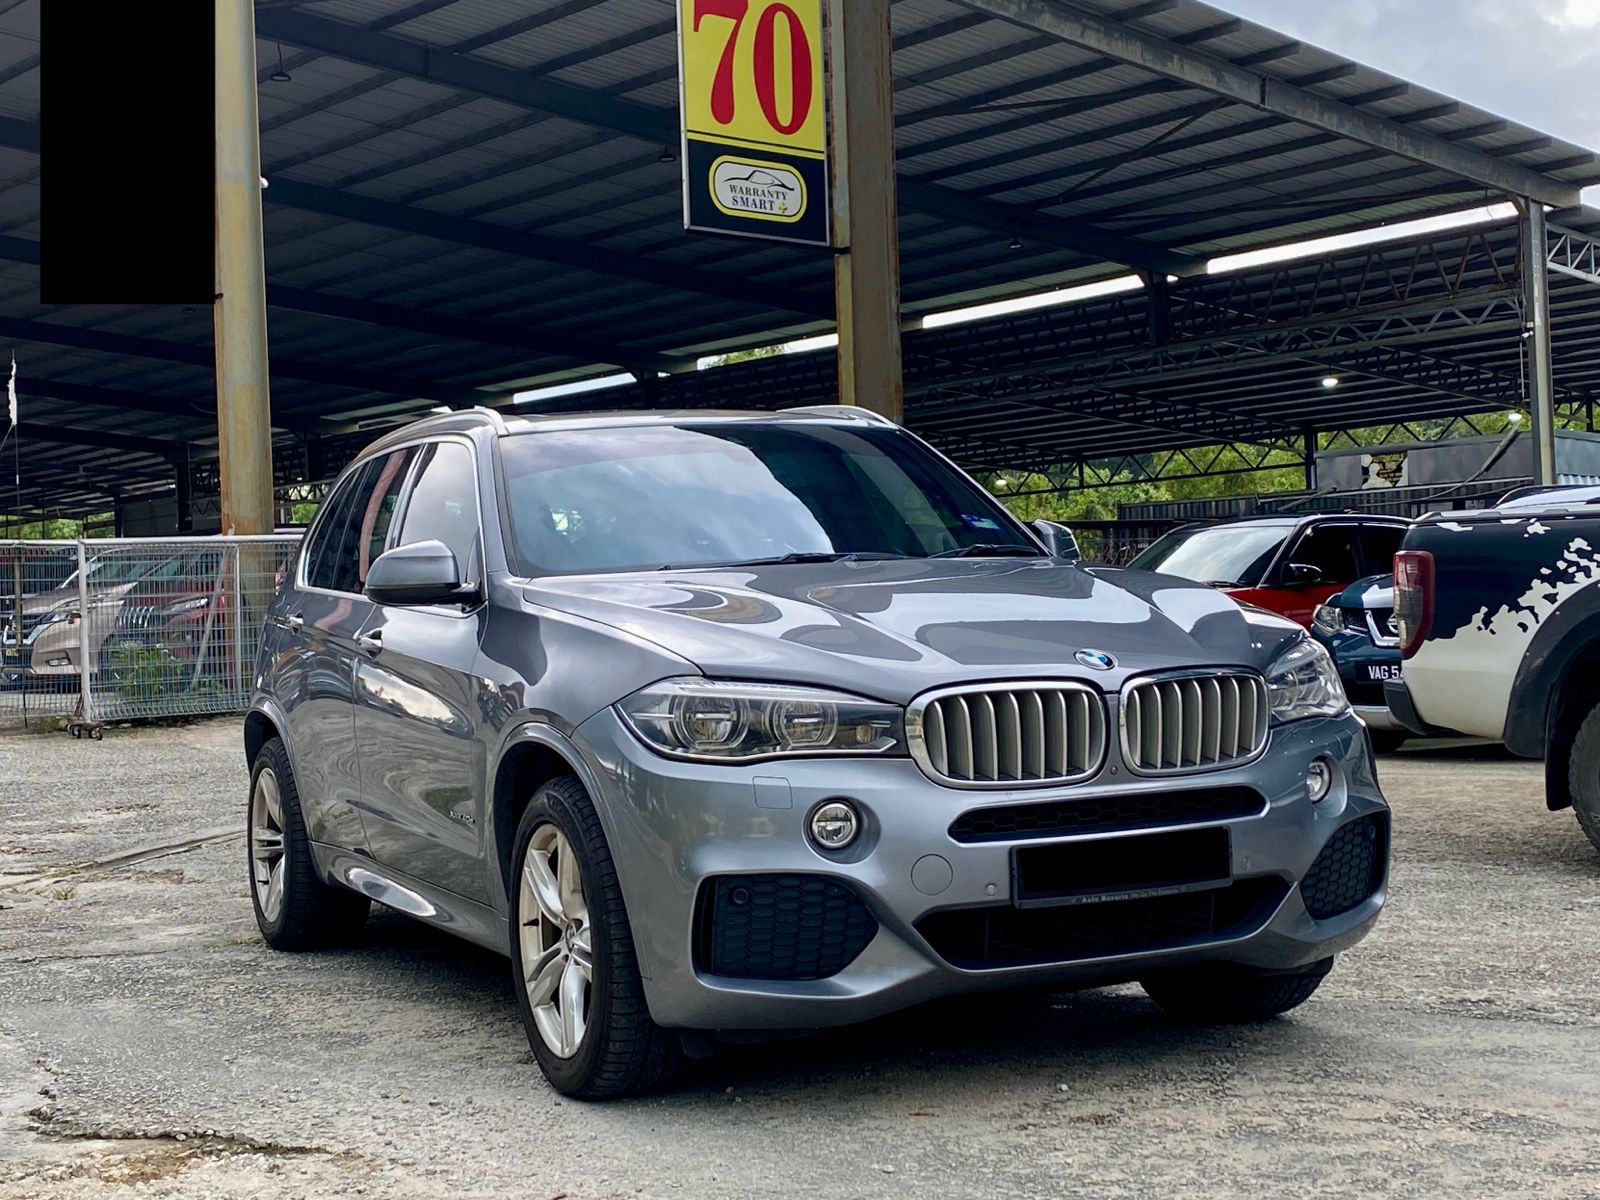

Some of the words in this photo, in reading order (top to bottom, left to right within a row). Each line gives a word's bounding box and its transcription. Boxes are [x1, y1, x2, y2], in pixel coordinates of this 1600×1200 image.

[693, 0, 813, 135] 70
[729, 184, 788, 200] WARRANTY
[732, 195, 775, 211] SMART
[1367, 665, 1389, 679] VAG
